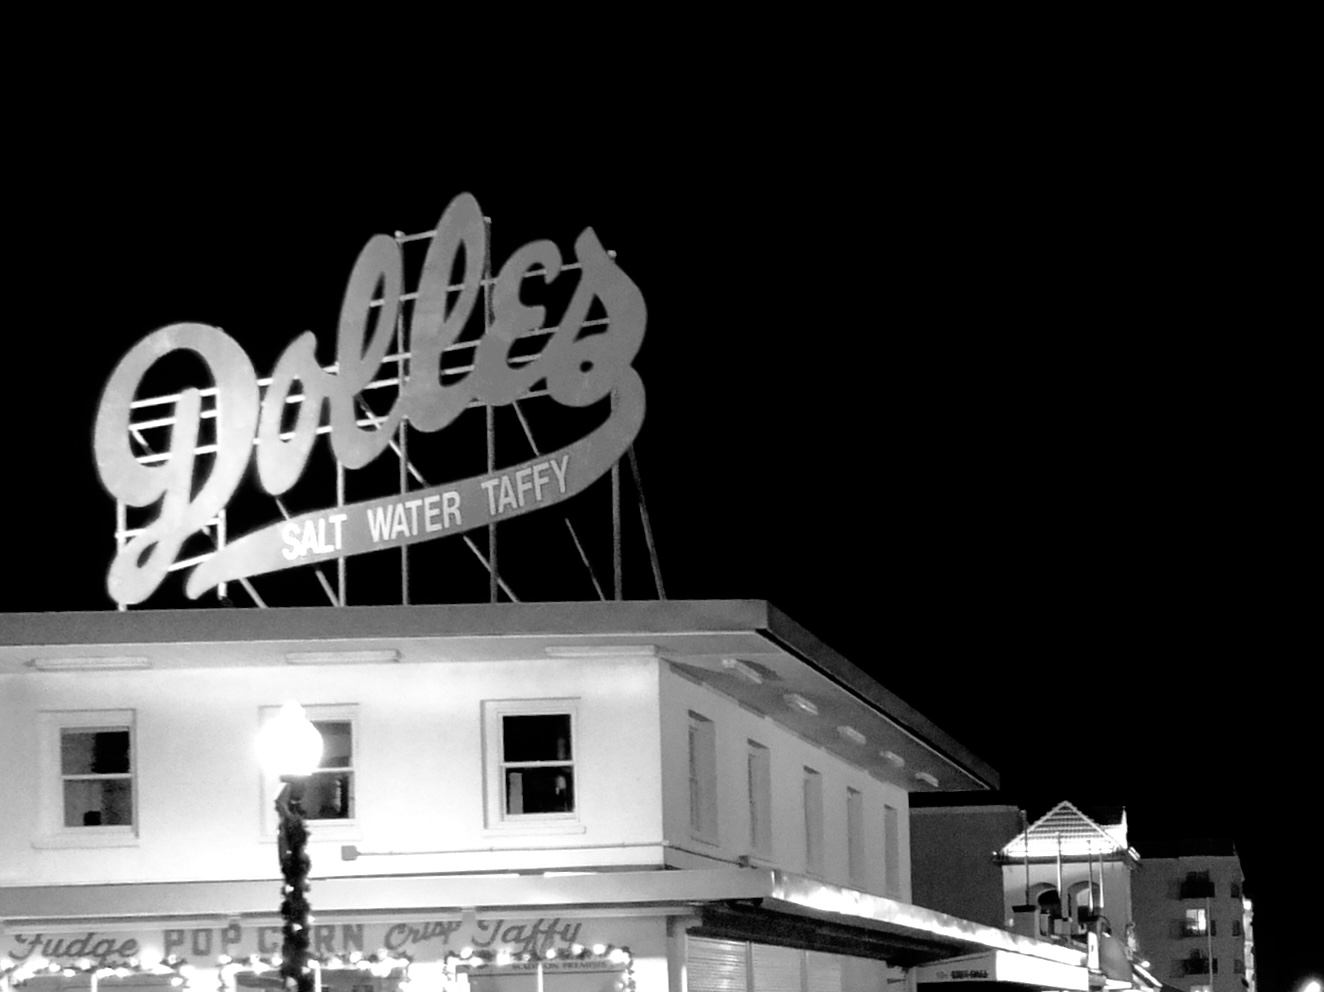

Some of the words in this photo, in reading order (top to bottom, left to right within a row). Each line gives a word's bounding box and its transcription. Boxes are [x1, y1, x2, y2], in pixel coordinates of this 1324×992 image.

[281, 513, 348, 561] SALT
[366, 490, 463, 543] WATER
[480, 455, 570, 516] TAFFY
[8, 932, 140, 966] Fudge
[163, 923, 242, 957] POP
[257, 923, 364, 953] CRN
[384, 921, 462, 950] Crisp
[471, 918, 584, 960] Taffy
